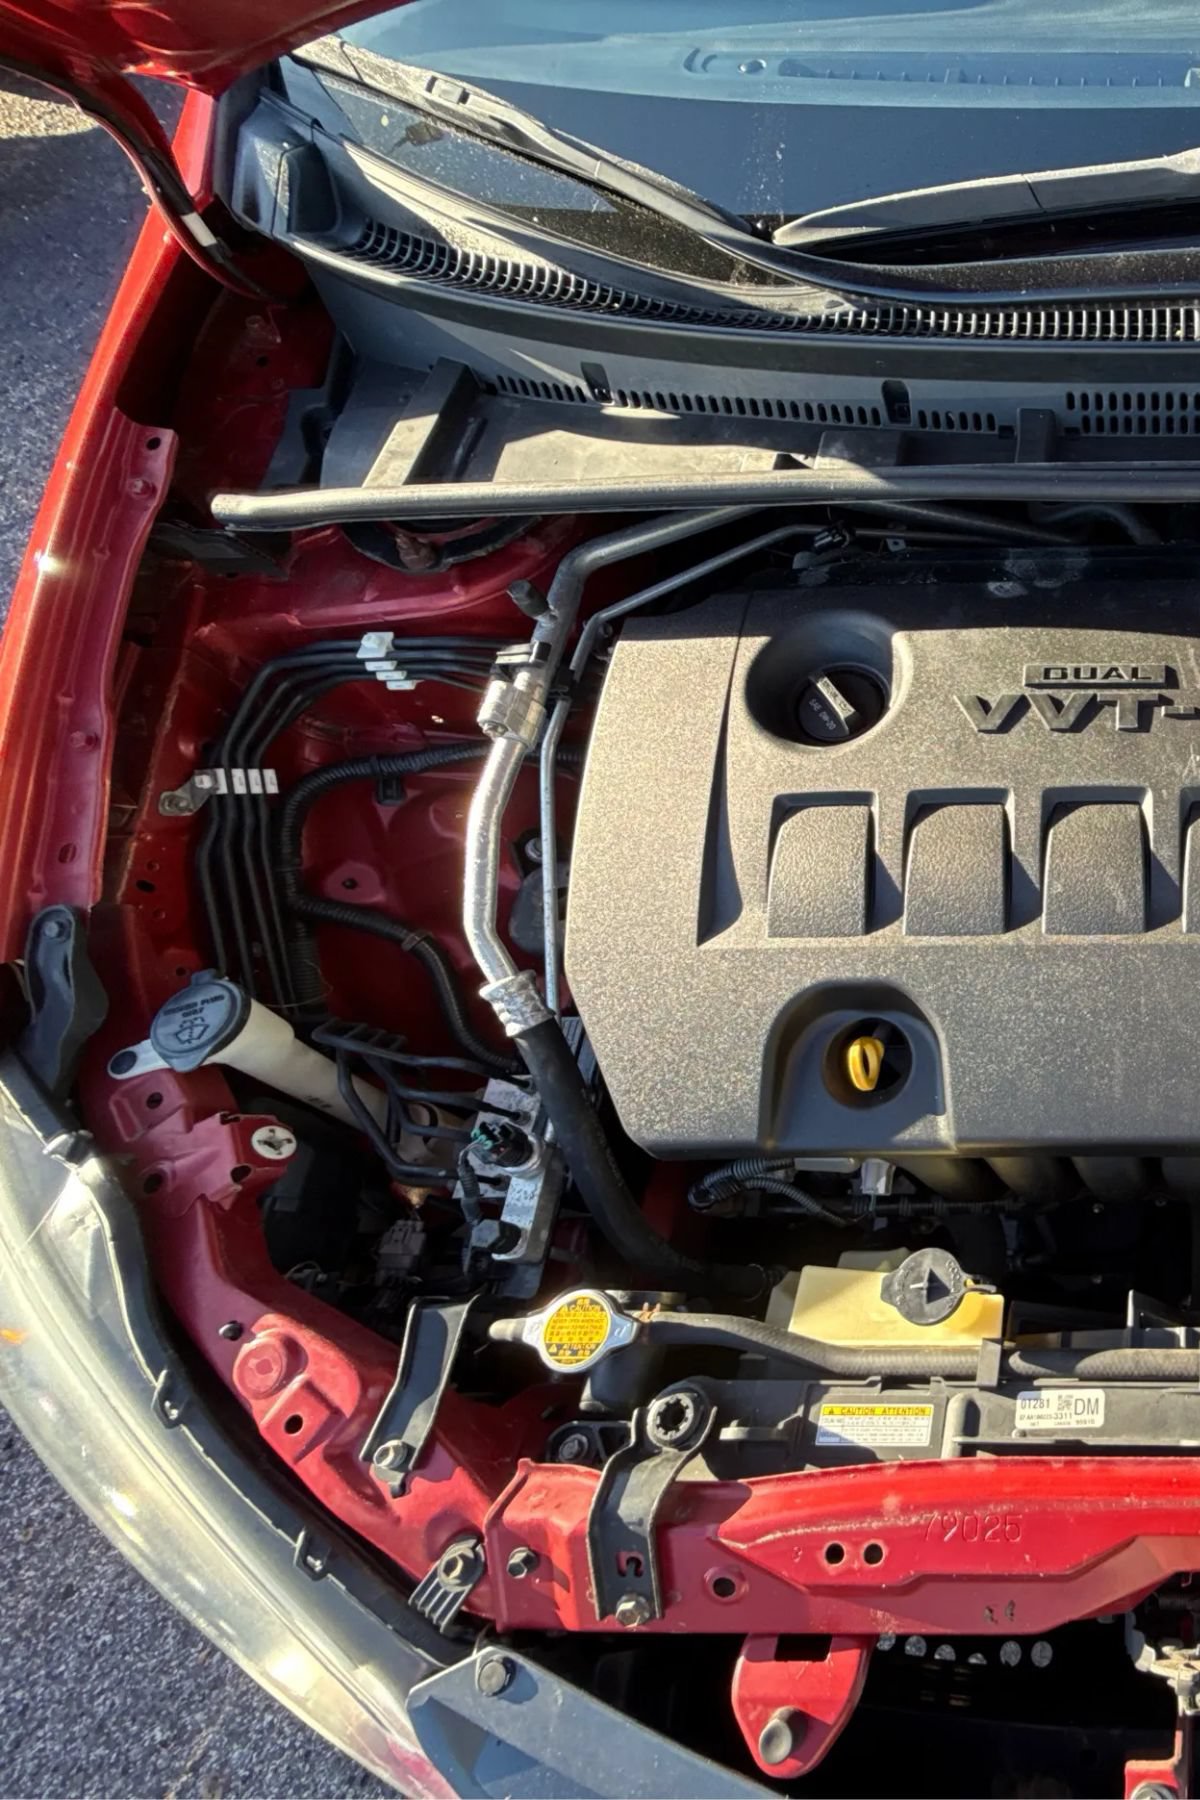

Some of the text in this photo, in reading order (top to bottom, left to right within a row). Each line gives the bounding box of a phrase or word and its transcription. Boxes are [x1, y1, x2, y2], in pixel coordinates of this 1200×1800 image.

[1043, 666, 1152, 681] DUAL
[841, 1406, 926, 1415] CAUTION ATTENTION
[1074, 1397, 1099, 1416] DM
[925, 1510, 1023, 1542] 79025
